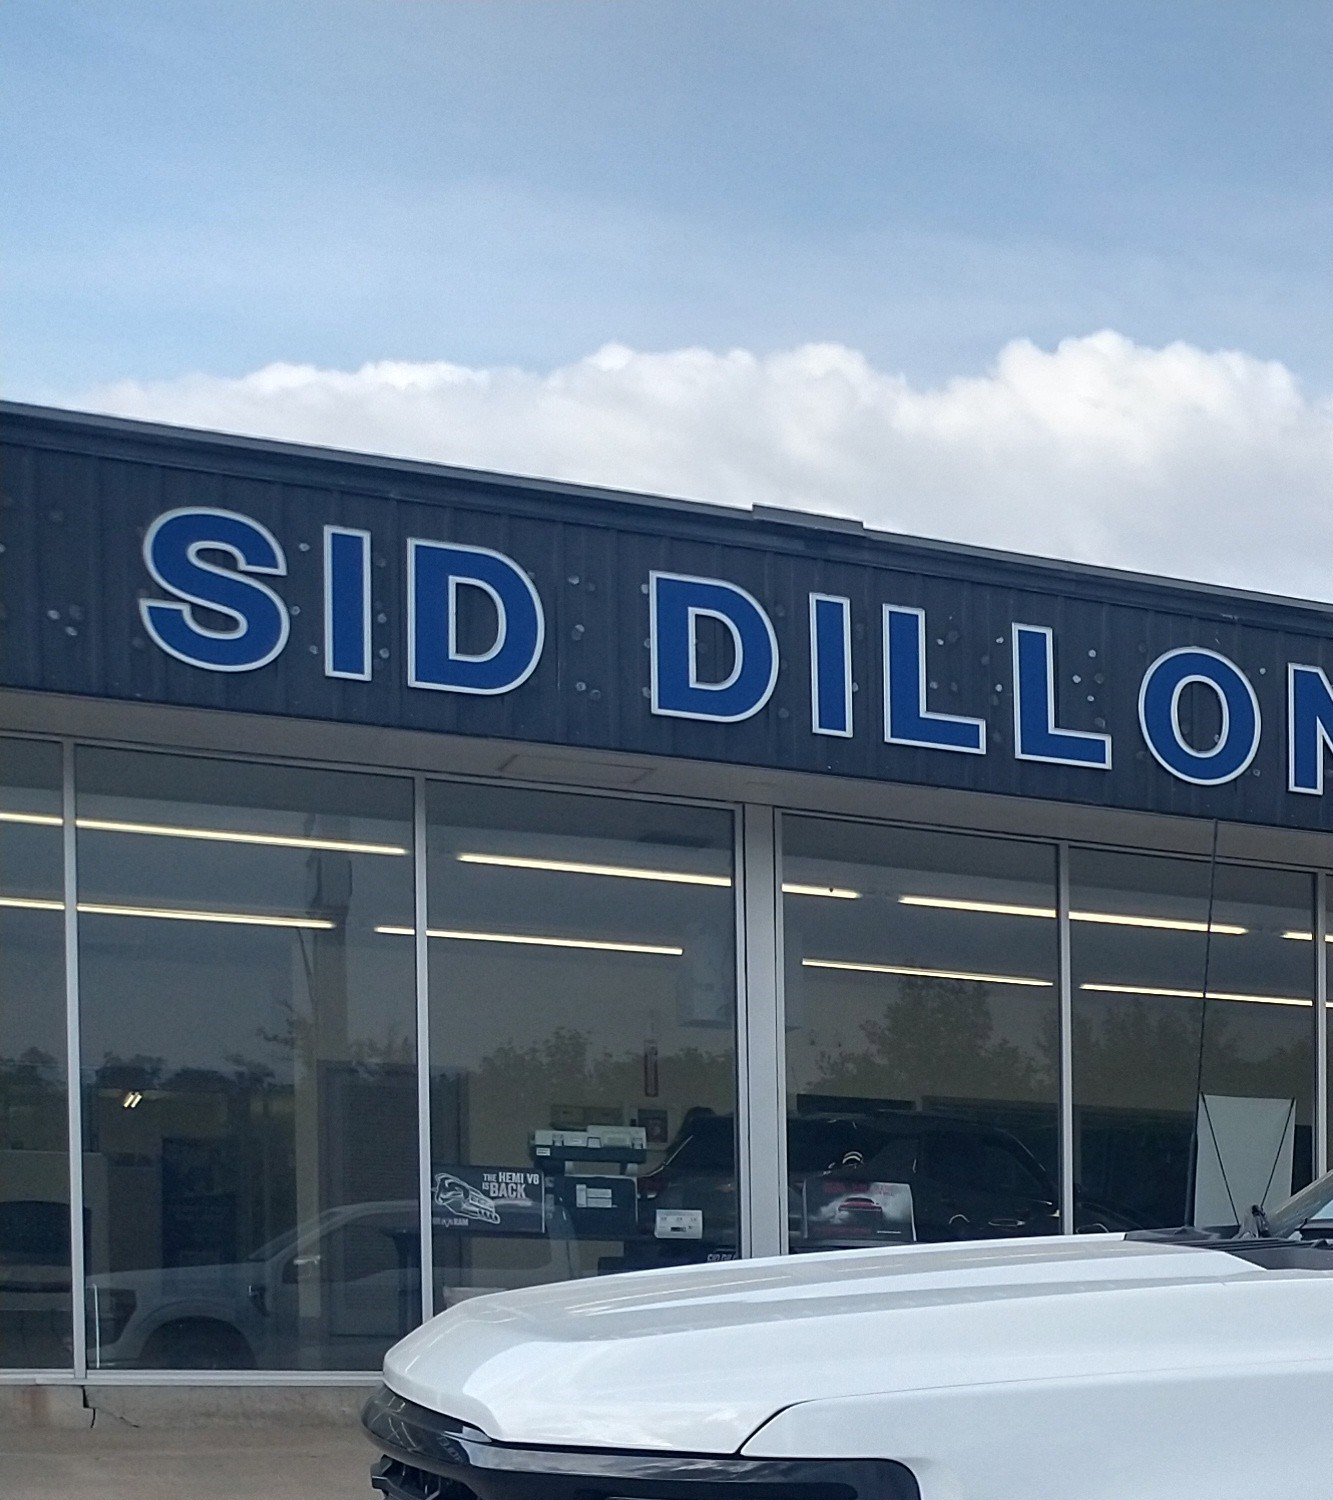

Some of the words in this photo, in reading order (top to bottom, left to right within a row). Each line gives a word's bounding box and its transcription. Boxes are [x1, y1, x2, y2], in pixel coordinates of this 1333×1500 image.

[141, 506, 545, 696] SID
[483, 1173, 497, 1182] THE
[499, 1171, 524, 1183] HEMI
[526, 1173, 539, 1184] V8
[482, 1182, 490, 1190] IS
[489, 1182, 526, 1199] BACK
